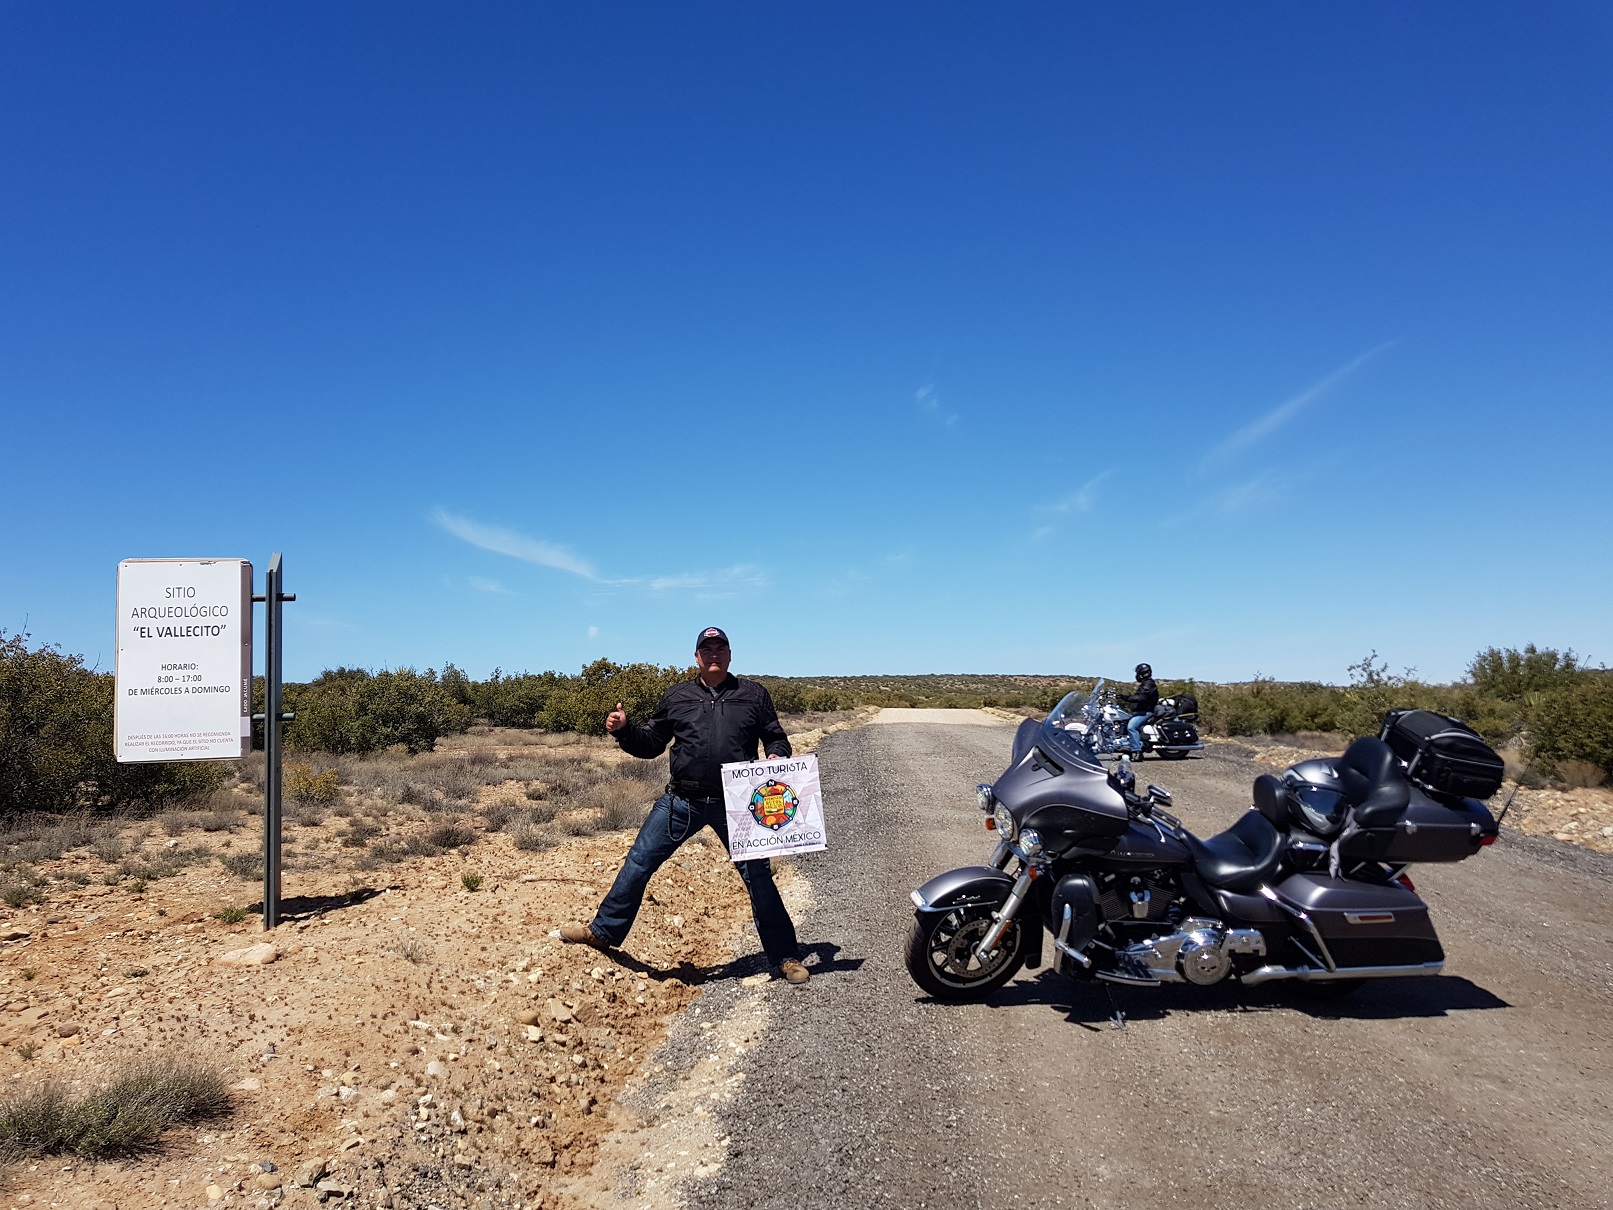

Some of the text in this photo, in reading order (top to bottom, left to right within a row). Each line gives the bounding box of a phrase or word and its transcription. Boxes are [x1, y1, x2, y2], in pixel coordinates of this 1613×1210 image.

[165, 586, 196, 598] SITIO
[131, 603, 229, 619] ARQUEOLÓGICO
[161, 662, 198, 671] HORARIO:
[157, 675, 174, 683] 8:00
[182, 674, 202, 682] 17:00
[128, 688, 138, 696] DE
[140, 686, 182, 696] MIÉRCOLES
[192, 685, 230, 694] DOMINGO
[732, 762, 808, 779] MOTO TURISTA
[732, 840, 744, 850] EN
[746, 835, 783, 848] ACCIÓN
[786, 831, 821, 843] MÉXICO
